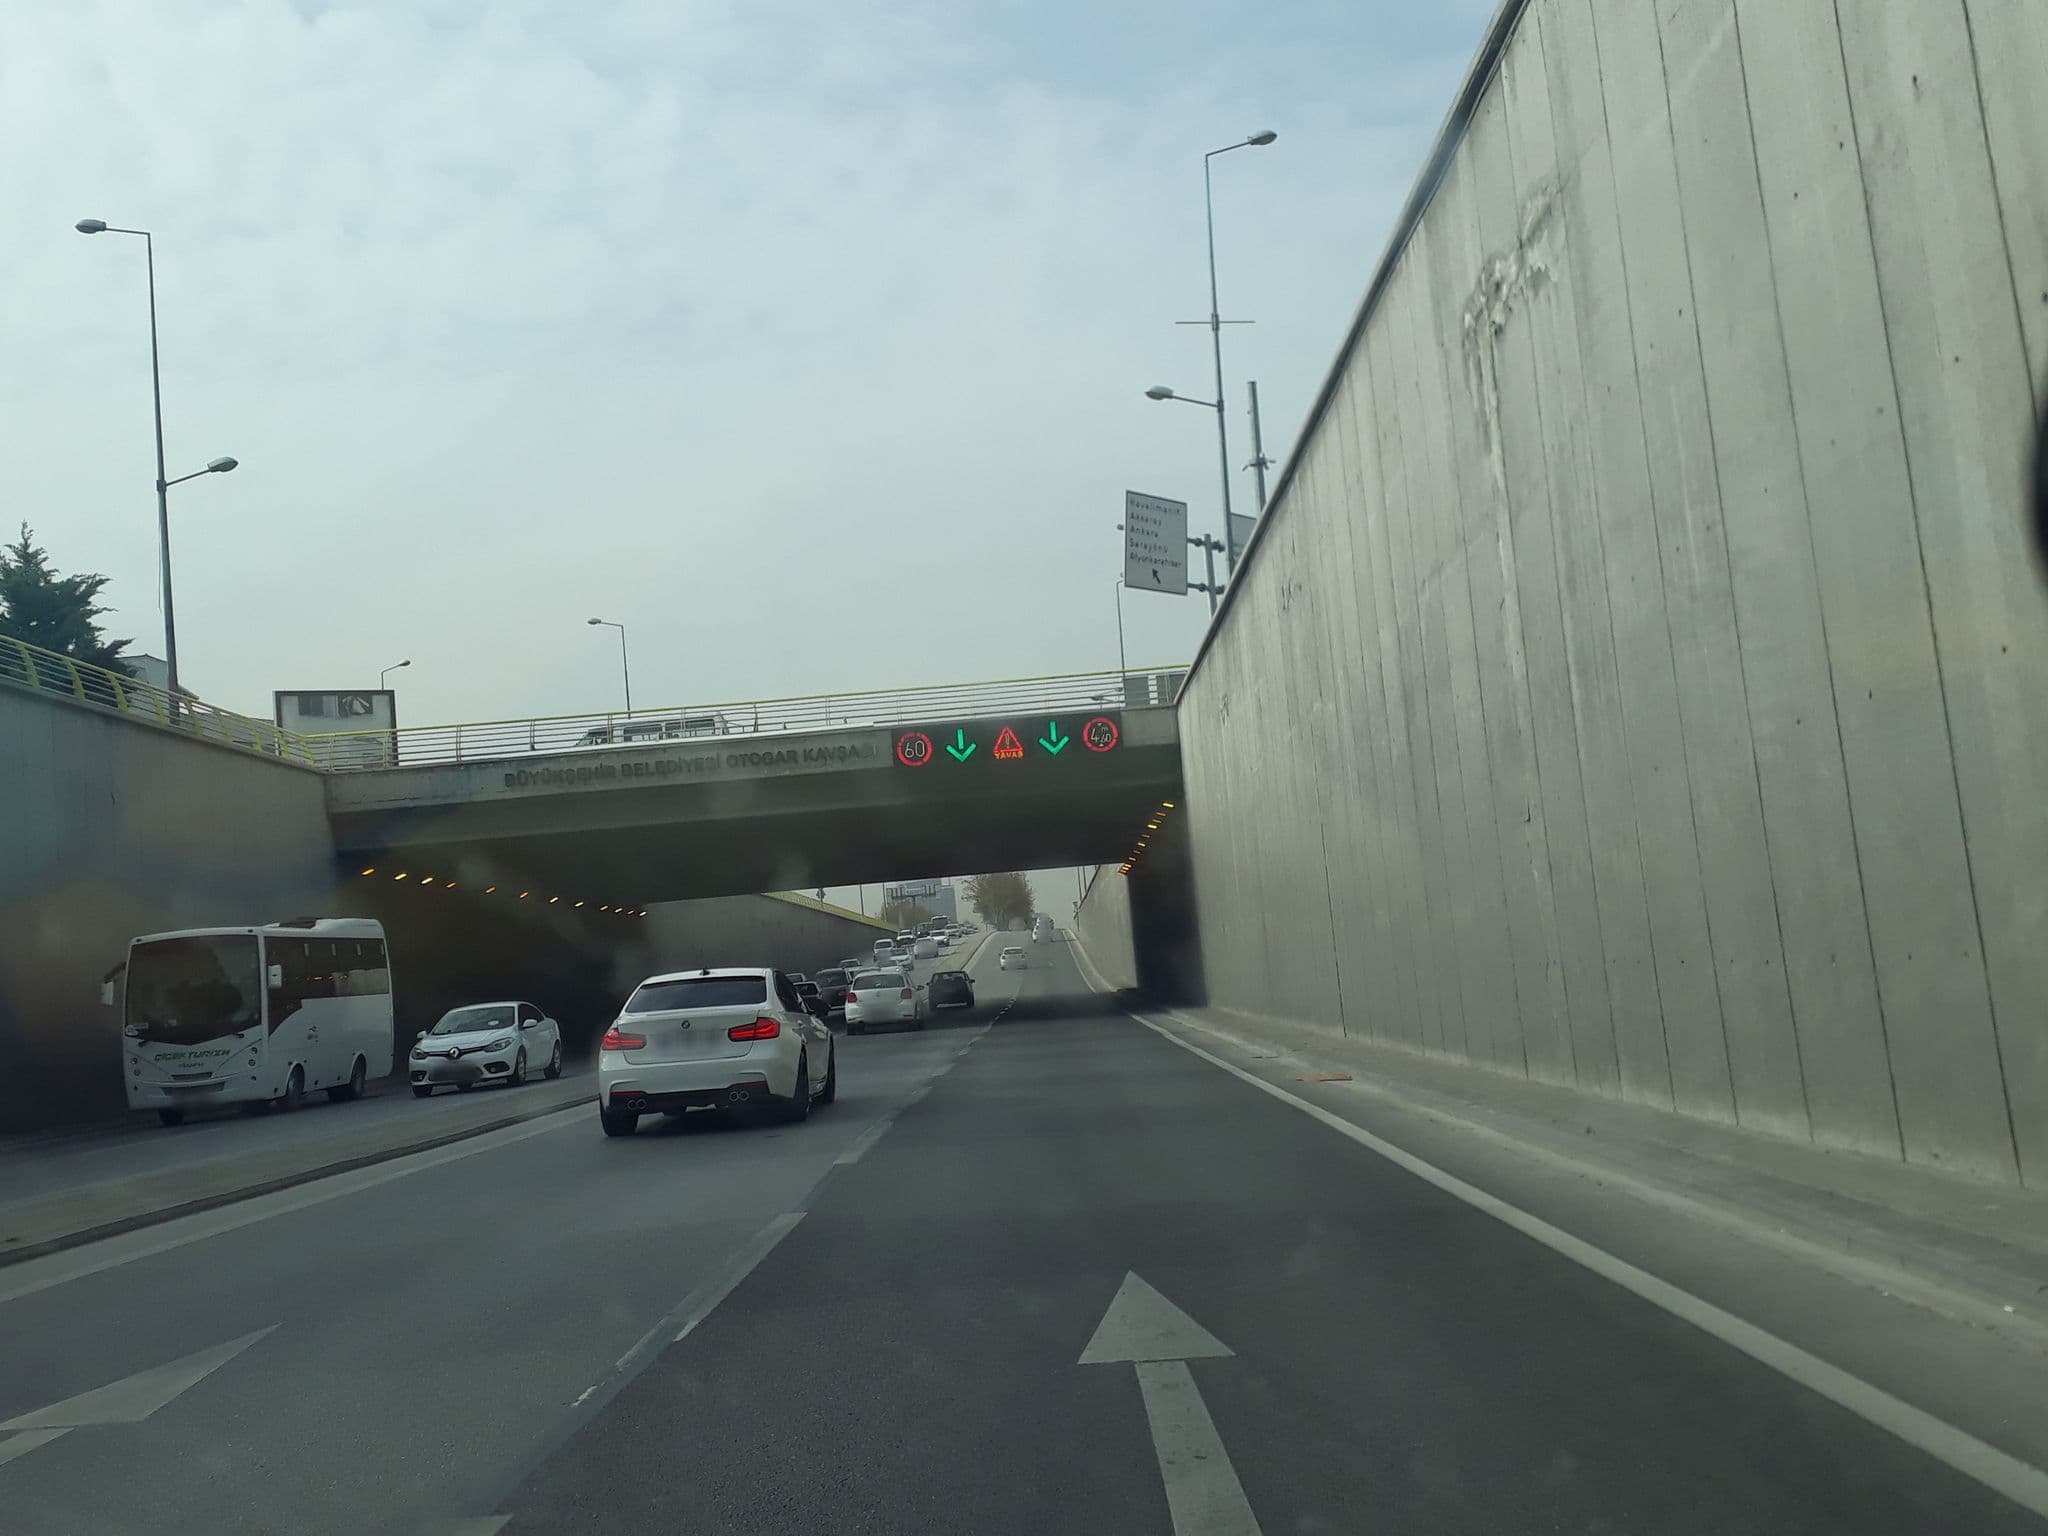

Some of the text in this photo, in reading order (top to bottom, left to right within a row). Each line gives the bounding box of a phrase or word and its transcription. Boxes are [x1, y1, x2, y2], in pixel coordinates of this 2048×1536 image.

[1130, 525, 1159, 538] Ankara
[904, 740, 926, 758] 60
[726, 749, 799, 768] OTOGAR
